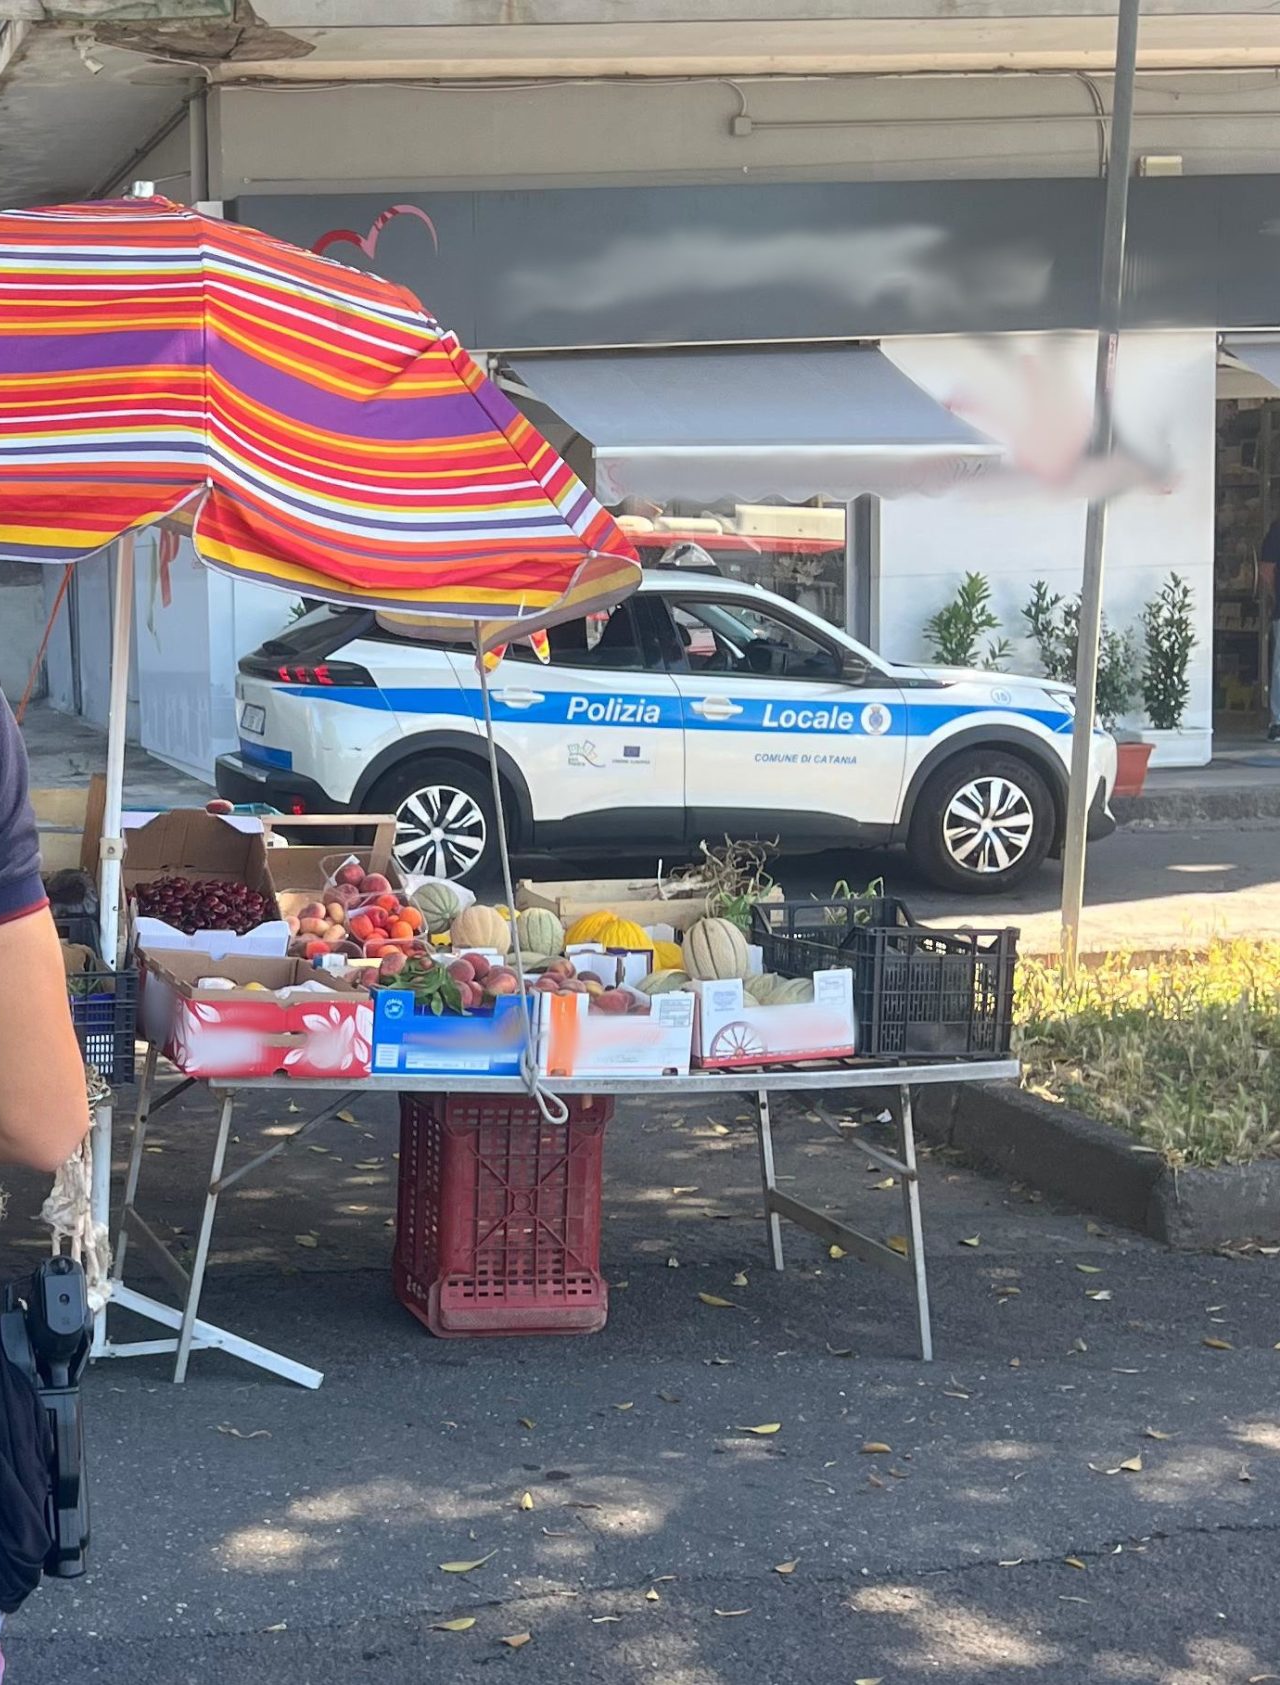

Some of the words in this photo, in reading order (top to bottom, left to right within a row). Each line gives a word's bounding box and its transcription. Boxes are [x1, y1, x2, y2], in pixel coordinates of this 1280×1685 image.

[567, 696, 661, 724] Polizia
[763, 704, 855, 730] Locale
[754, 752, 798, 764] COMUNE
[800, 753, 812, 764] DI
[813, 754, 858, 765] CATANIA
